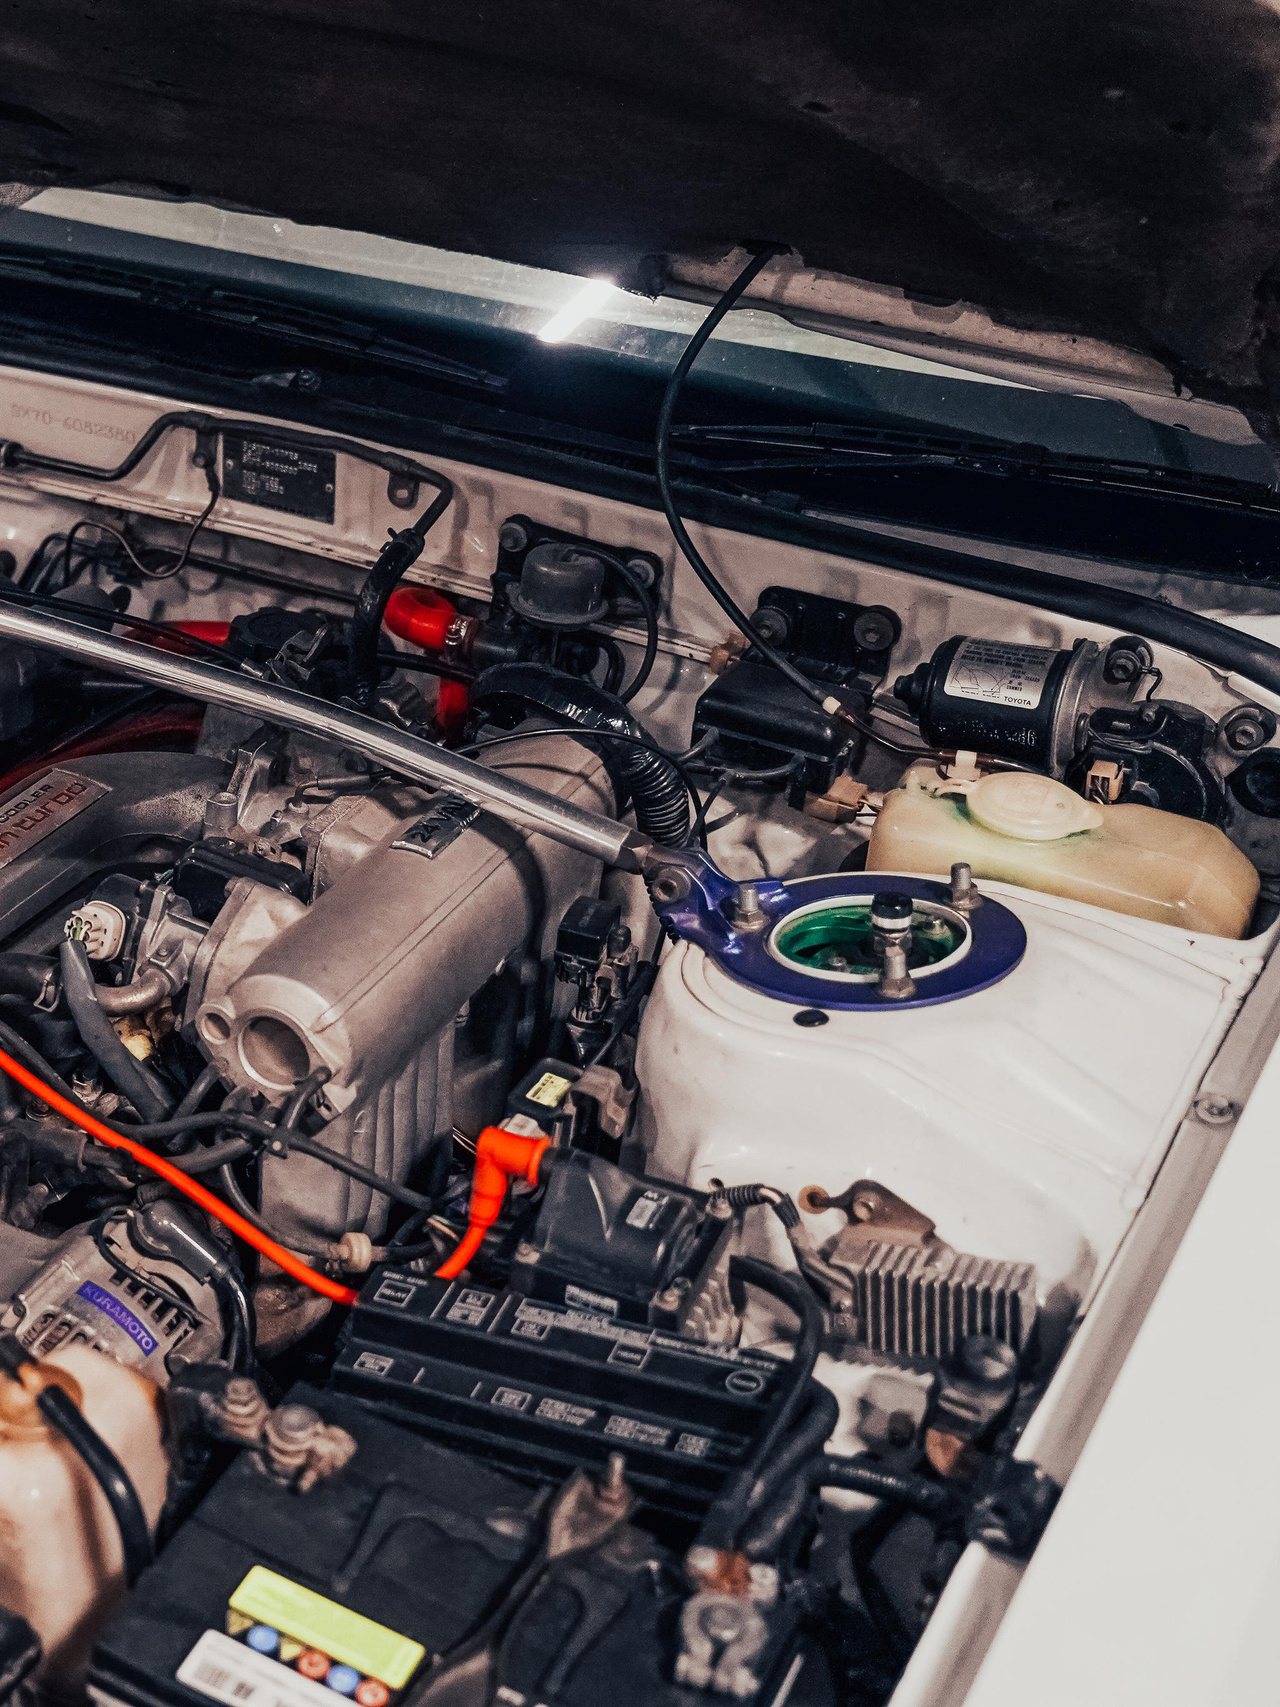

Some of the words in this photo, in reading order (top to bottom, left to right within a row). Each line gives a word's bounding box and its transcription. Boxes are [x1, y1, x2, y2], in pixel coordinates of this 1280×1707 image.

[1004, 695, 1032, 707] TOYOTA
[13, 781, 88, 831] turbo
[410, 824, 440, 843] 24
[429, 793, 465, 821] VAL
[82, 1286, 153, 1350] KURAMOTO
